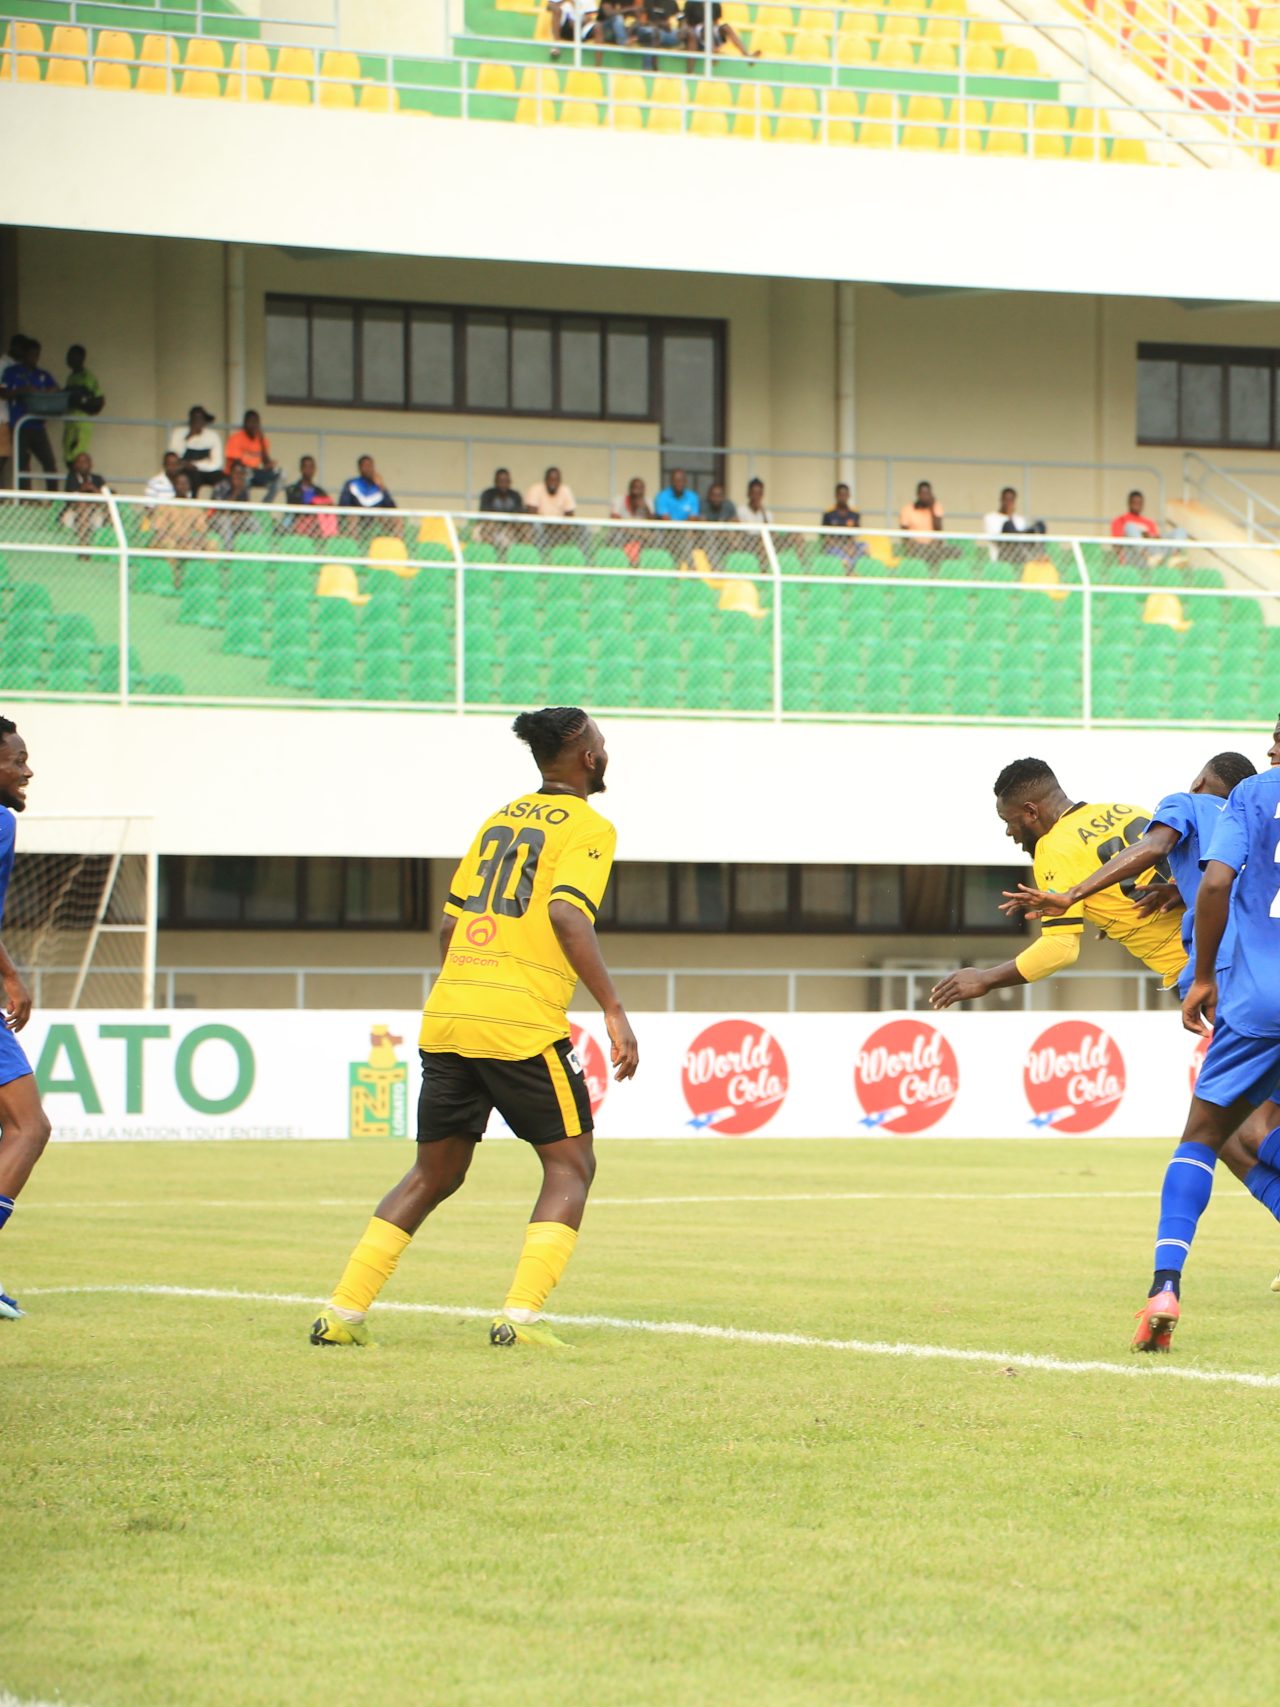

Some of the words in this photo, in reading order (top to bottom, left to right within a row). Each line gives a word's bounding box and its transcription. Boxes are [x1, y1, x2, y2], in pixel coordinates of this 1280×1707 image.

[493, 802, 570, 825] ASKO
[1077, 803, 1133, 846] ASKO
[463, 825, 546, 918] 30
[681, 1031, 773, 1086] World
[854, 1031, 943, 1085] World
[1022, 1031, 1110, 1085] World
[727, 1067, 785, 1106] Cola
[899, 1067, 957, 1106] Cola
[1067, 1067, 1122, 1106] Cola
